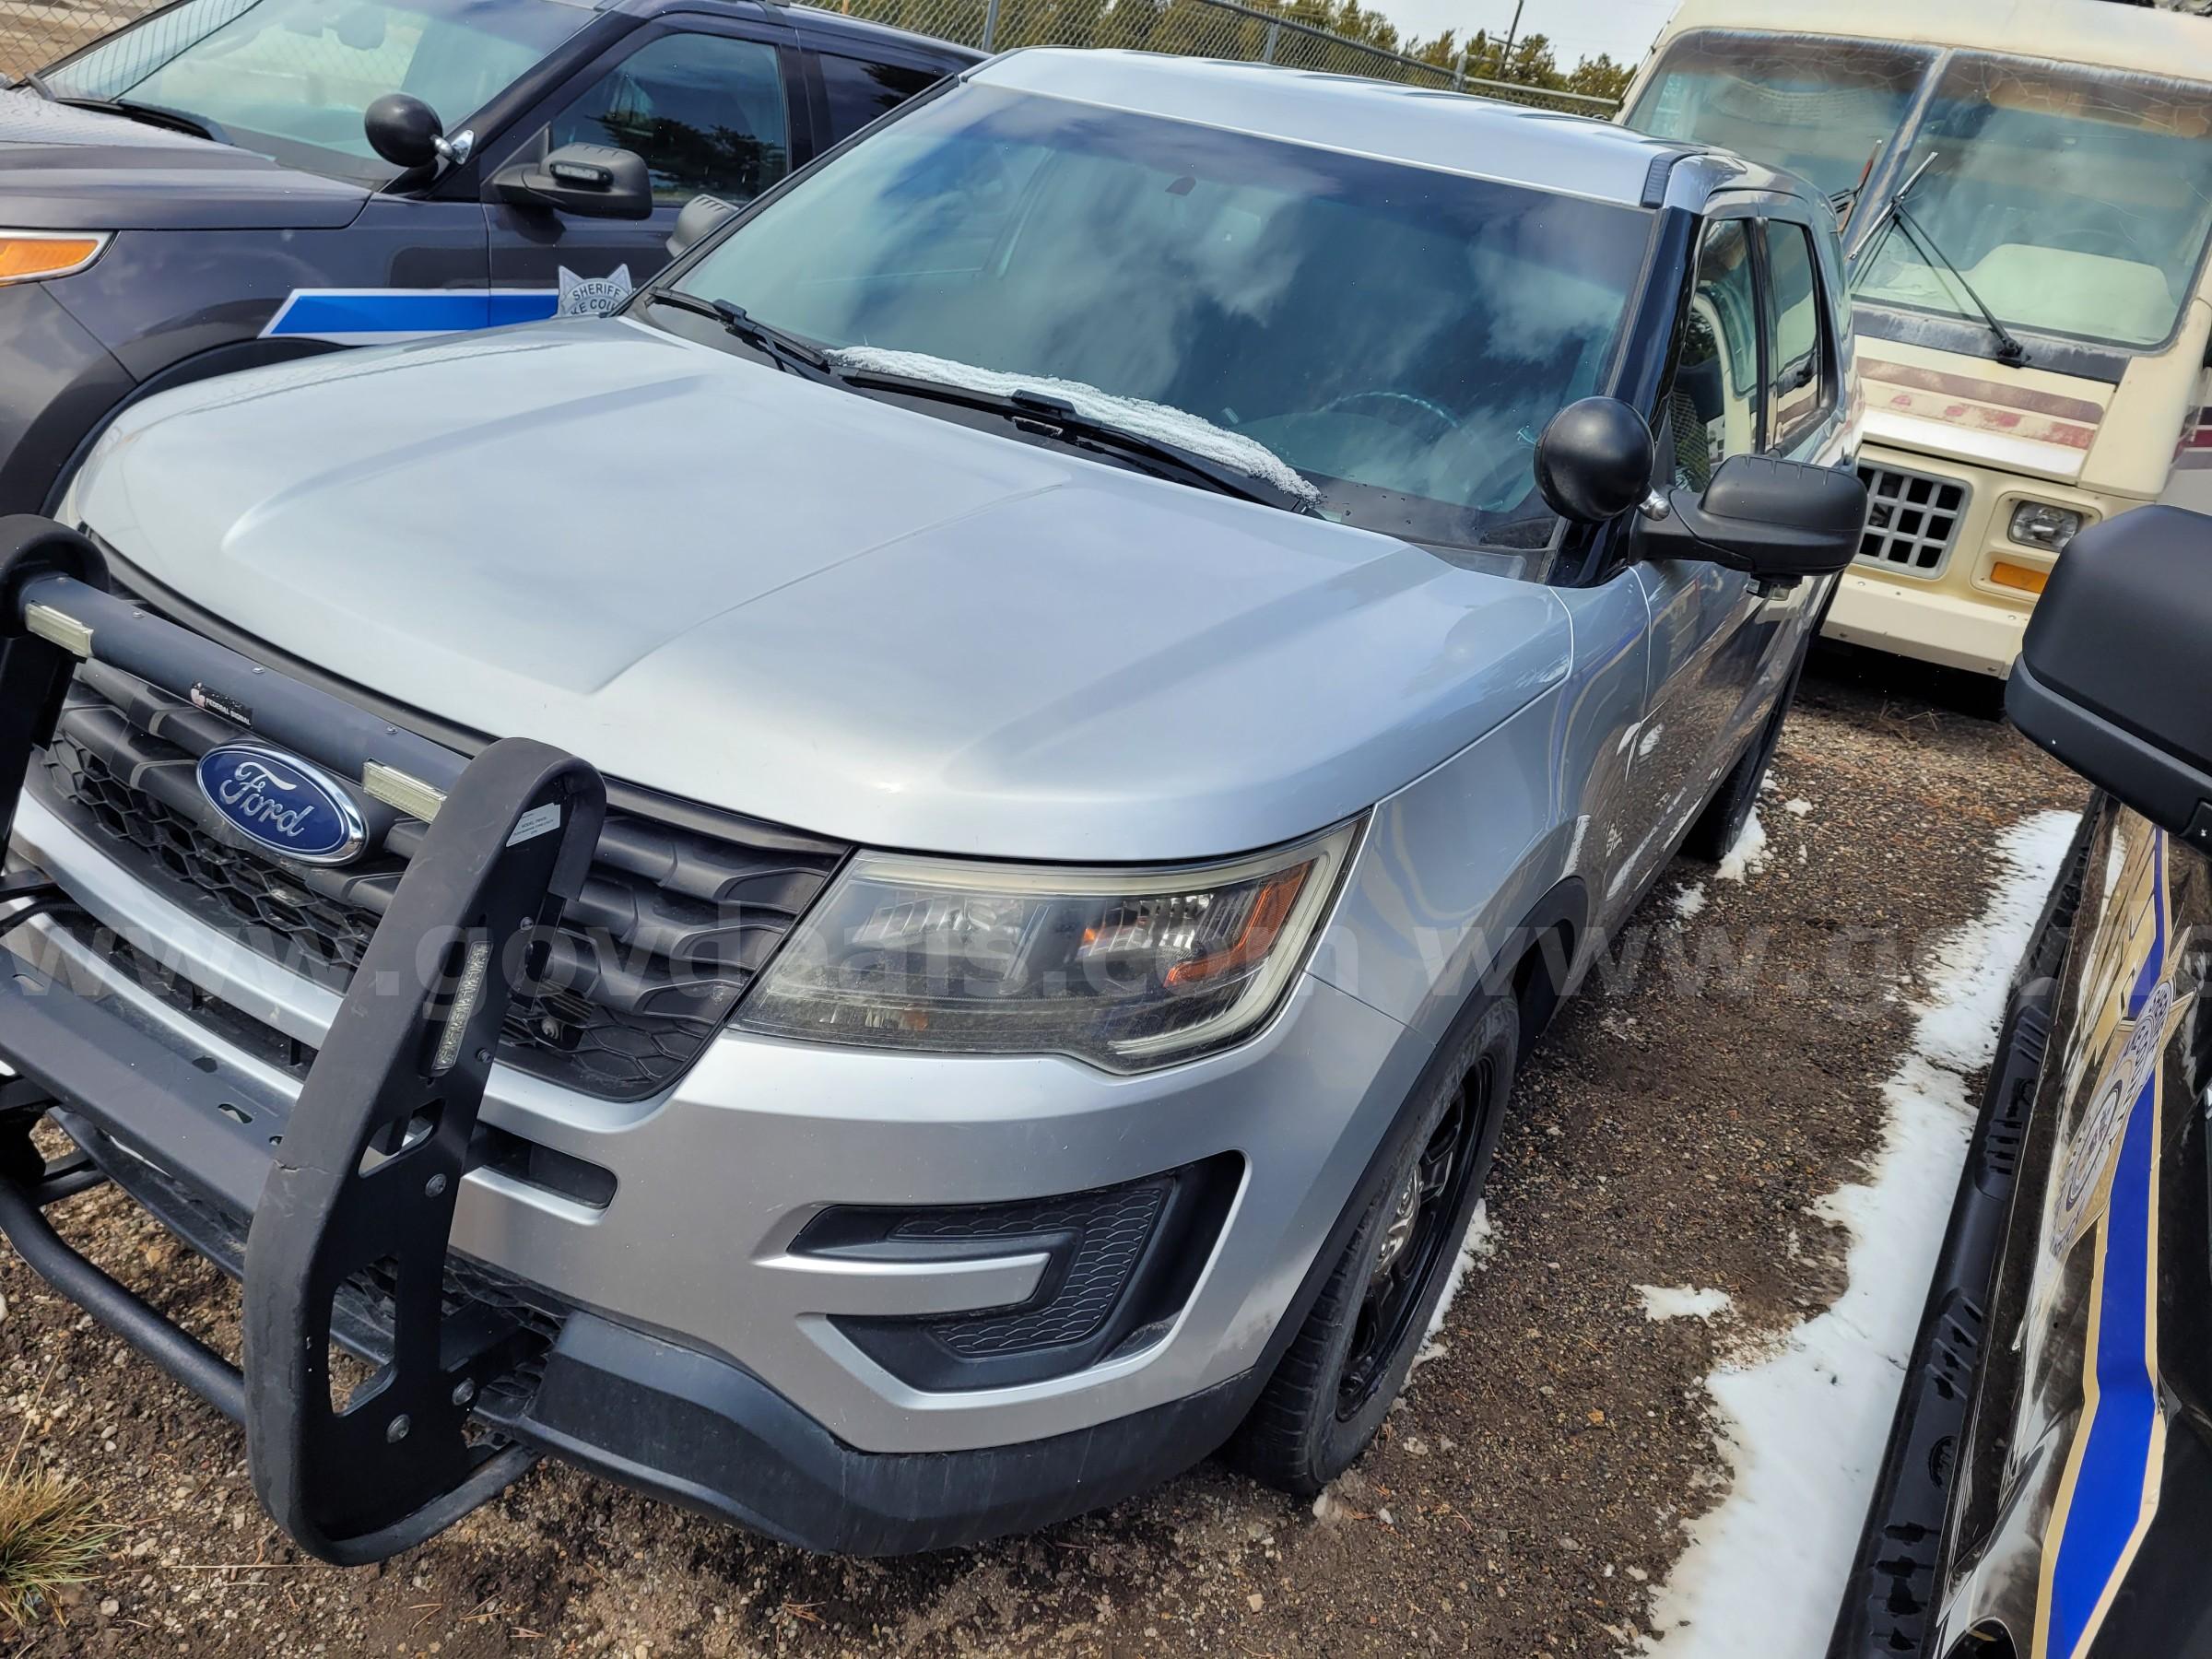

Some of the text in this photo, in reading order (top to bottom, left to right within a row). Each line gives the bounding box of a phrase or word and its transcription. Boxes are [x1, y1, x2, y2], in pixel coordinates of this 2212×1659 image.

[572, 283, 620, 300] SHERIFF
[206, 697, 230, 715] FEDERAL
[219, 760, 315, 837] Ford
[2148, 989, 2169, 1053] SHERIFF
